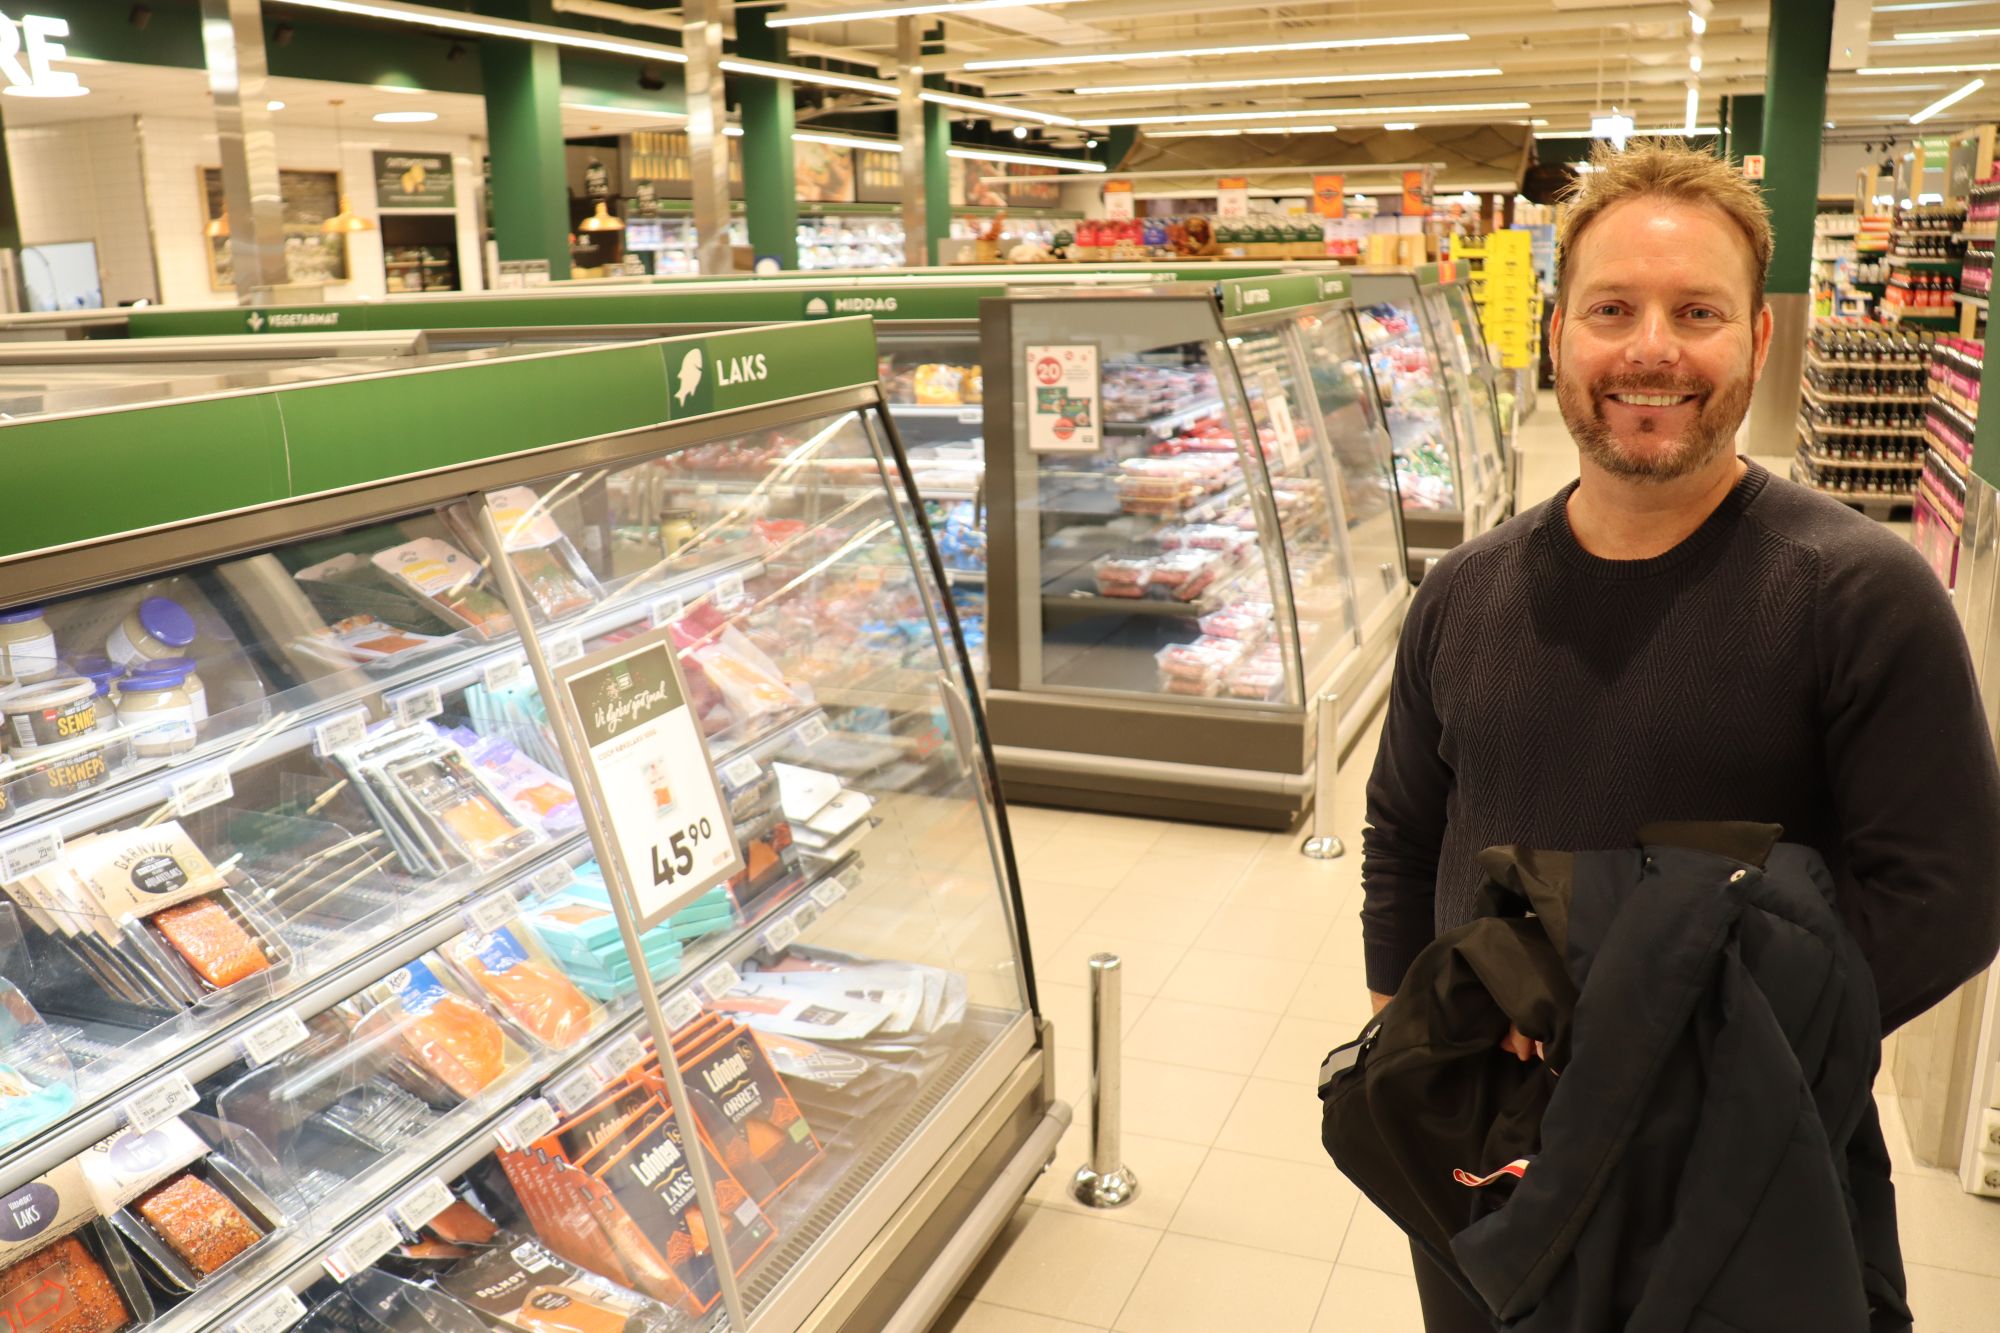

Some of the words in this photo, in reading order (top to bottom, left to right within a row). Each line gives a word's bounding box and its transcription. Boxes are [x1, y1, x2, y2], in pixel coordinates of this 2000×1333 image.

[267, 312, 339, 328] VEGETARMAT
[834, 297, 898, 312] MIDDAG
[716, 353, 768, 387] LAKS
[1037, 362, 1062, 380] 20
[47, 754, 105, 788] SENNEPS
[114, 842, 174, 871] GARNVIK
[702, 1053, 748, 1093] Lofoten
[629, 1139, 681, 1188] Lofoten
[660, 1171, 695, 1207] LAKS
[12, 1204, 41, 1231] LAKS
